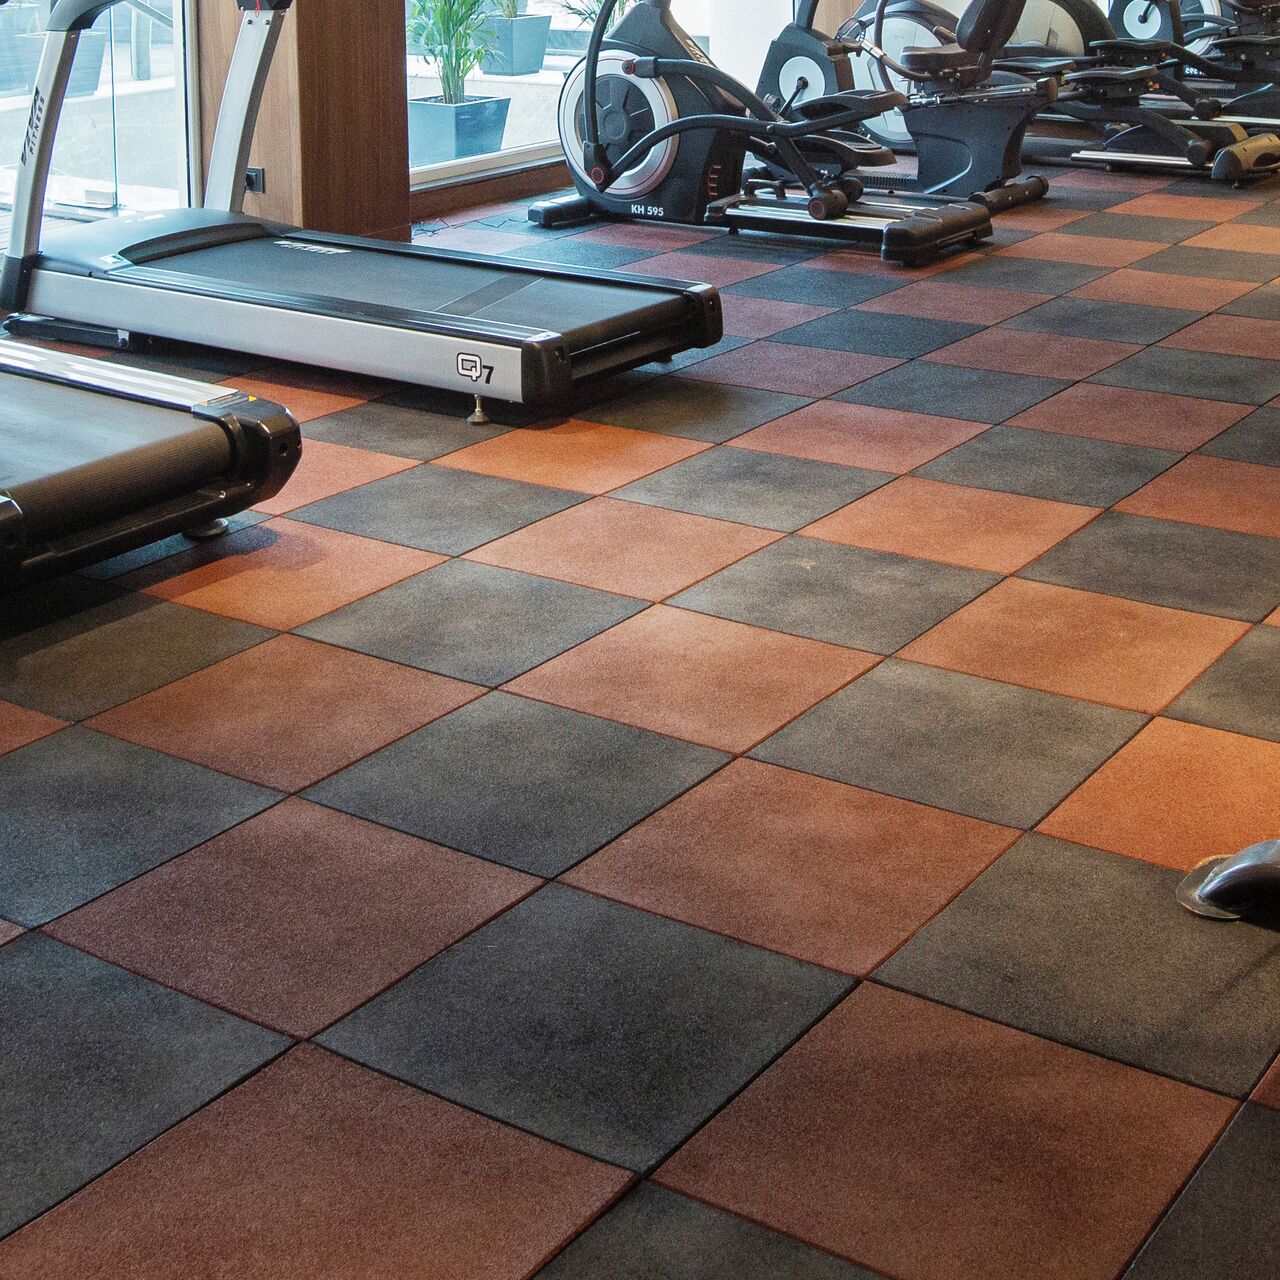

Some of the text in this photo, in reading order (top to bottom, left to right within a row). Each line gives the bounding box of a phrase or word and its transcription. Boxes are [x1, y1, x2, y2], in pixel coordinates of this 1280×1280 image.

[29, 95, 45, 155] FITNESS
[631, 204, 664, 216] KH 595
[456, 352, 495, 385] Q7
